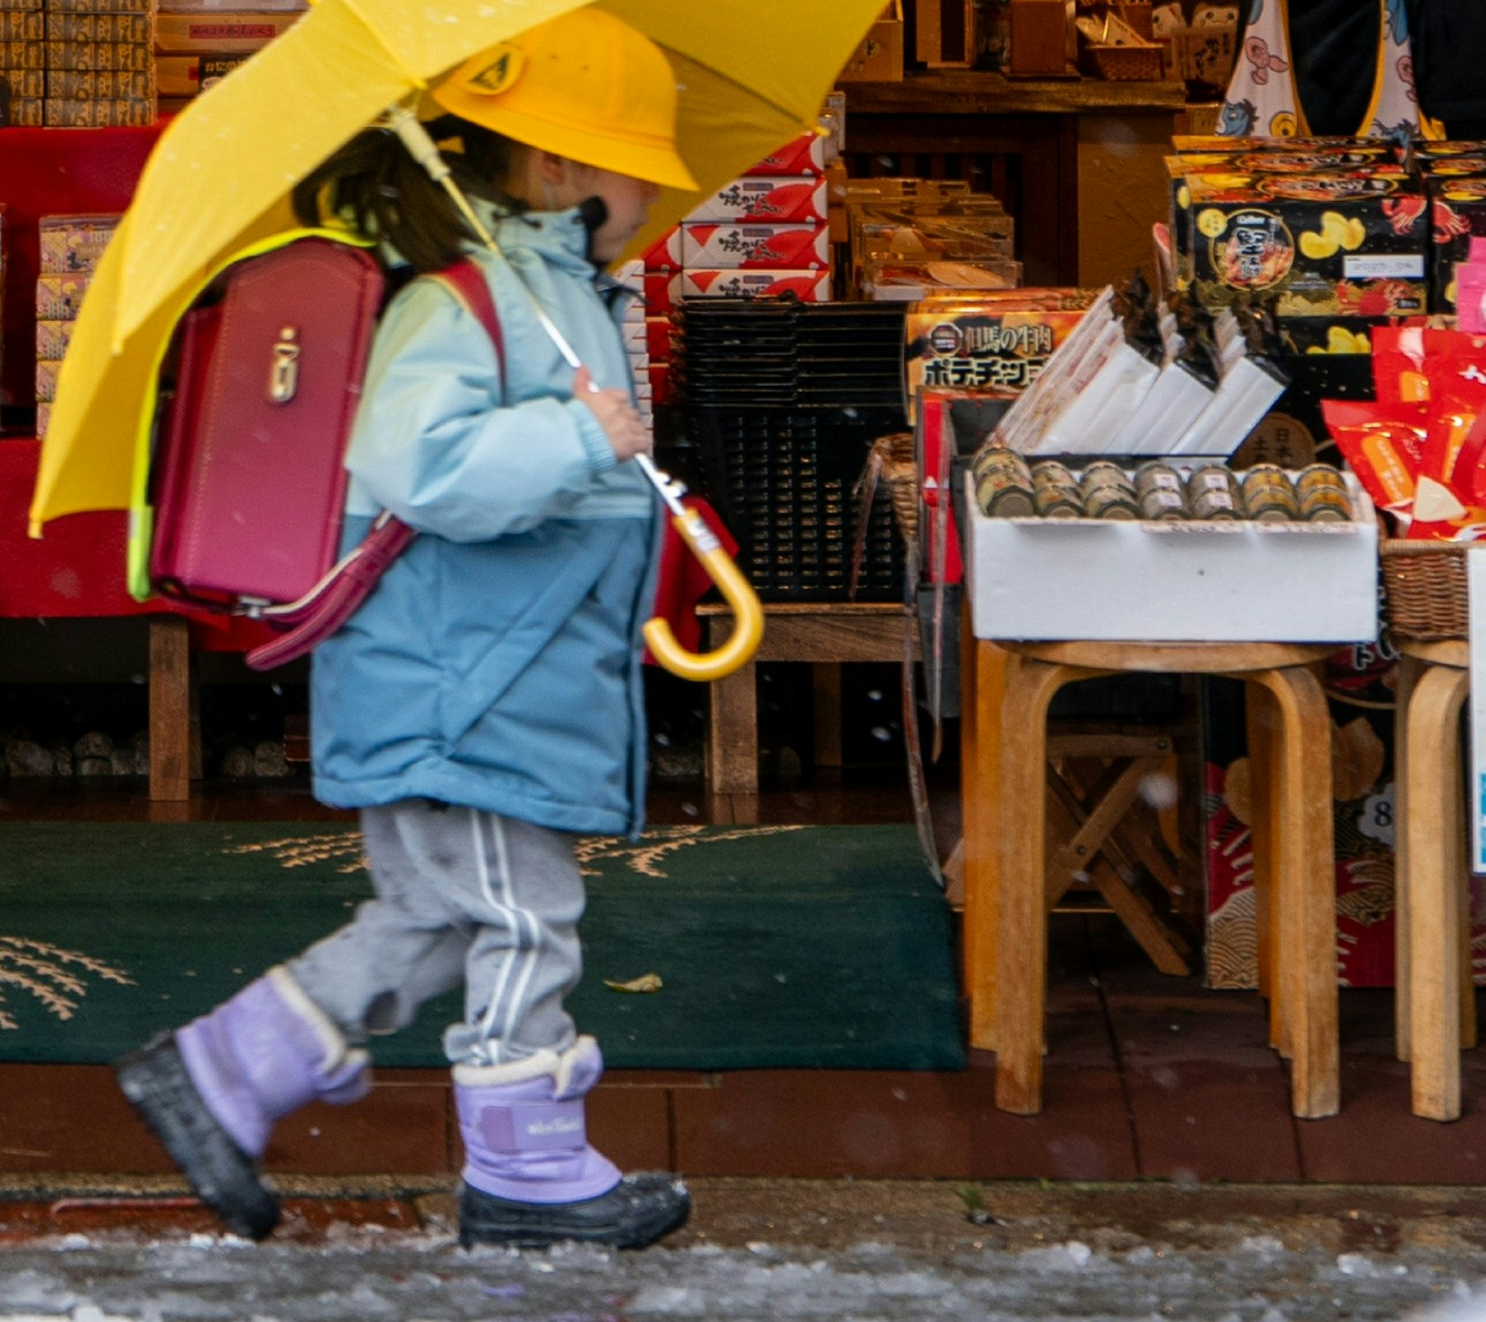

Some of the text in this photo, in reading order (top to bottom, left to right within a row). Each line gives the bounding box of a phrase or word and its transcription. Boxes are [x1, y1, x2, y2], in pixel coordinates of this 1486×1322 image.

[964, 325, 1054, 354] 但馬の牛肉
